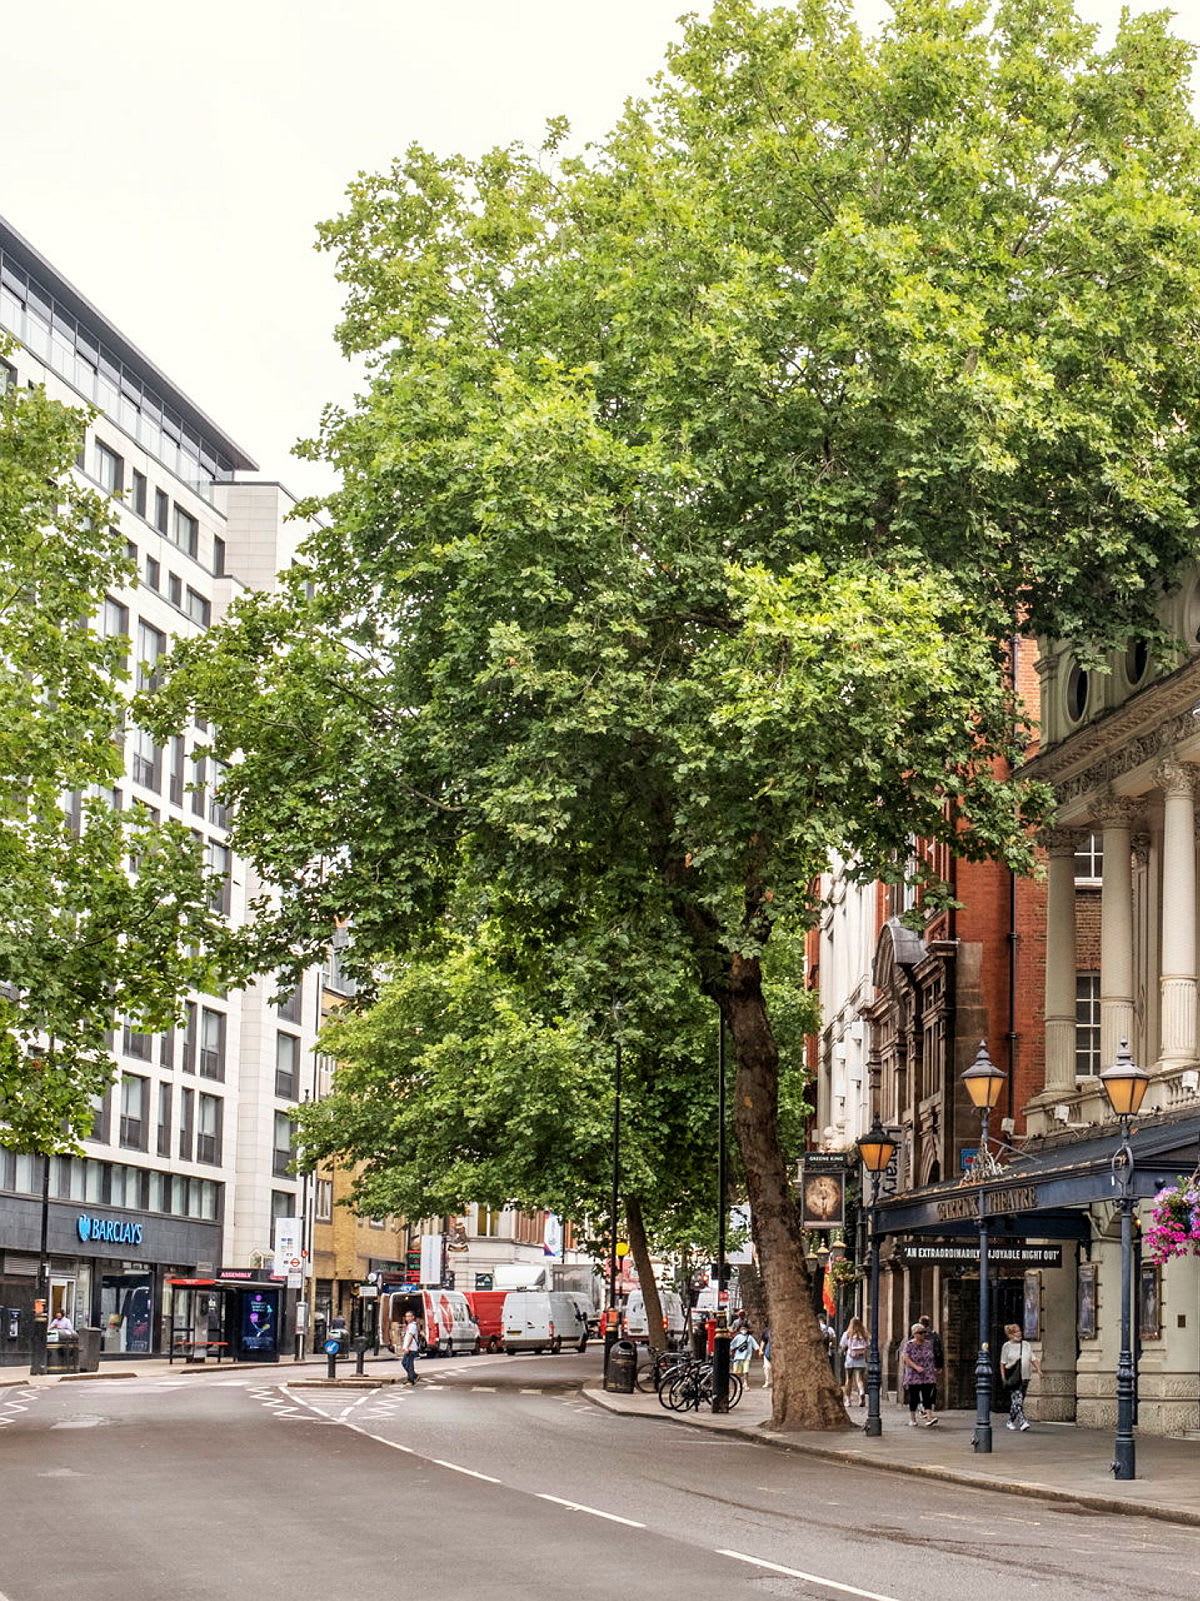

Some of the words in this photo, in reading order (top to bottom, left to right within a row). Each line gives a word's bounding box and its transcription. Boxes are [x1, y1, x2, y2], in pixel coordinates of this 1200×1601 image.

[92, 1219, 143, 1244] BARCLAYS
[918, 1247, 980, 1259] EXTRAORDINARILY
[988, 1249, 1020, 1259] NJOYABLE
[1022, 1250, 1042, 1260] NIGHT
[220, 1271, 252, 1279] ASSEMBLY
